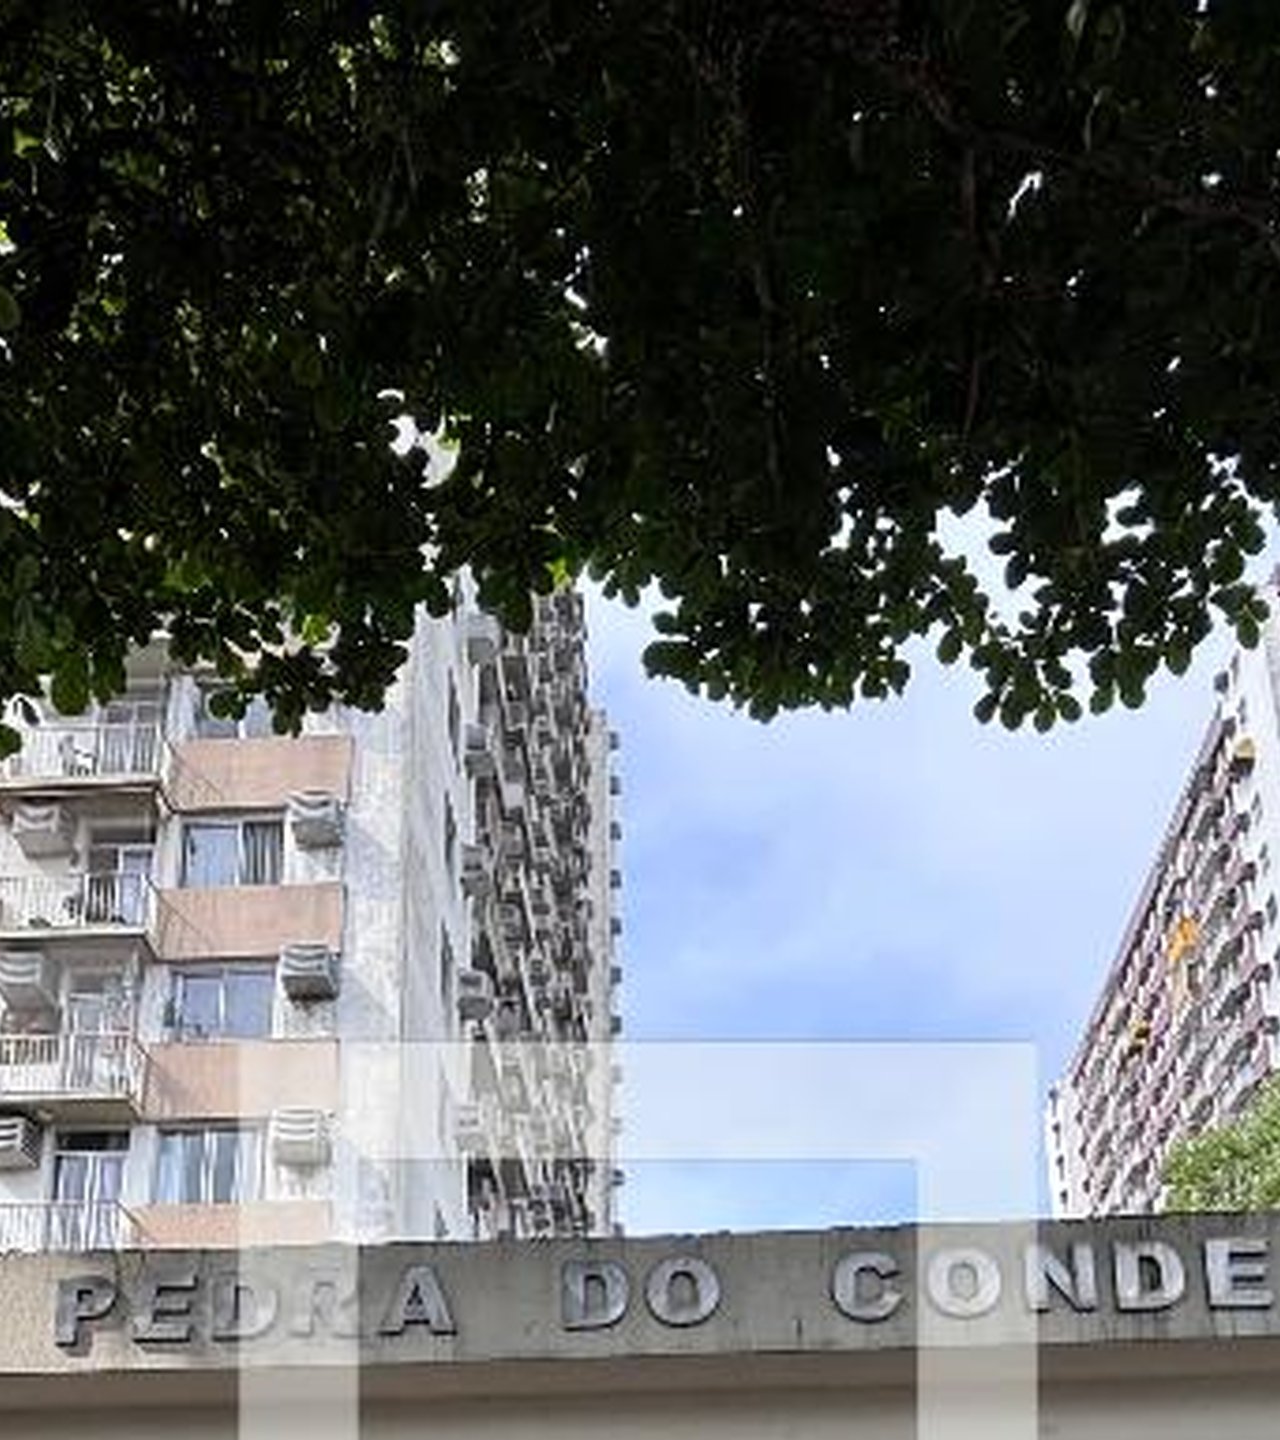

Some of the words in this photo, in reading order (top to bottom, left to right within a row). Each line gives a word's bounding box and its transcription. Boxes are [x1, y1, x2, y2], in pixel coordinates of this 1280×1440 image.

[55, 1263, 458, 1349] PEDRA
[560, 1256, 722, 1332] DO
[831, 1237, 1275, 1323] CONDE
